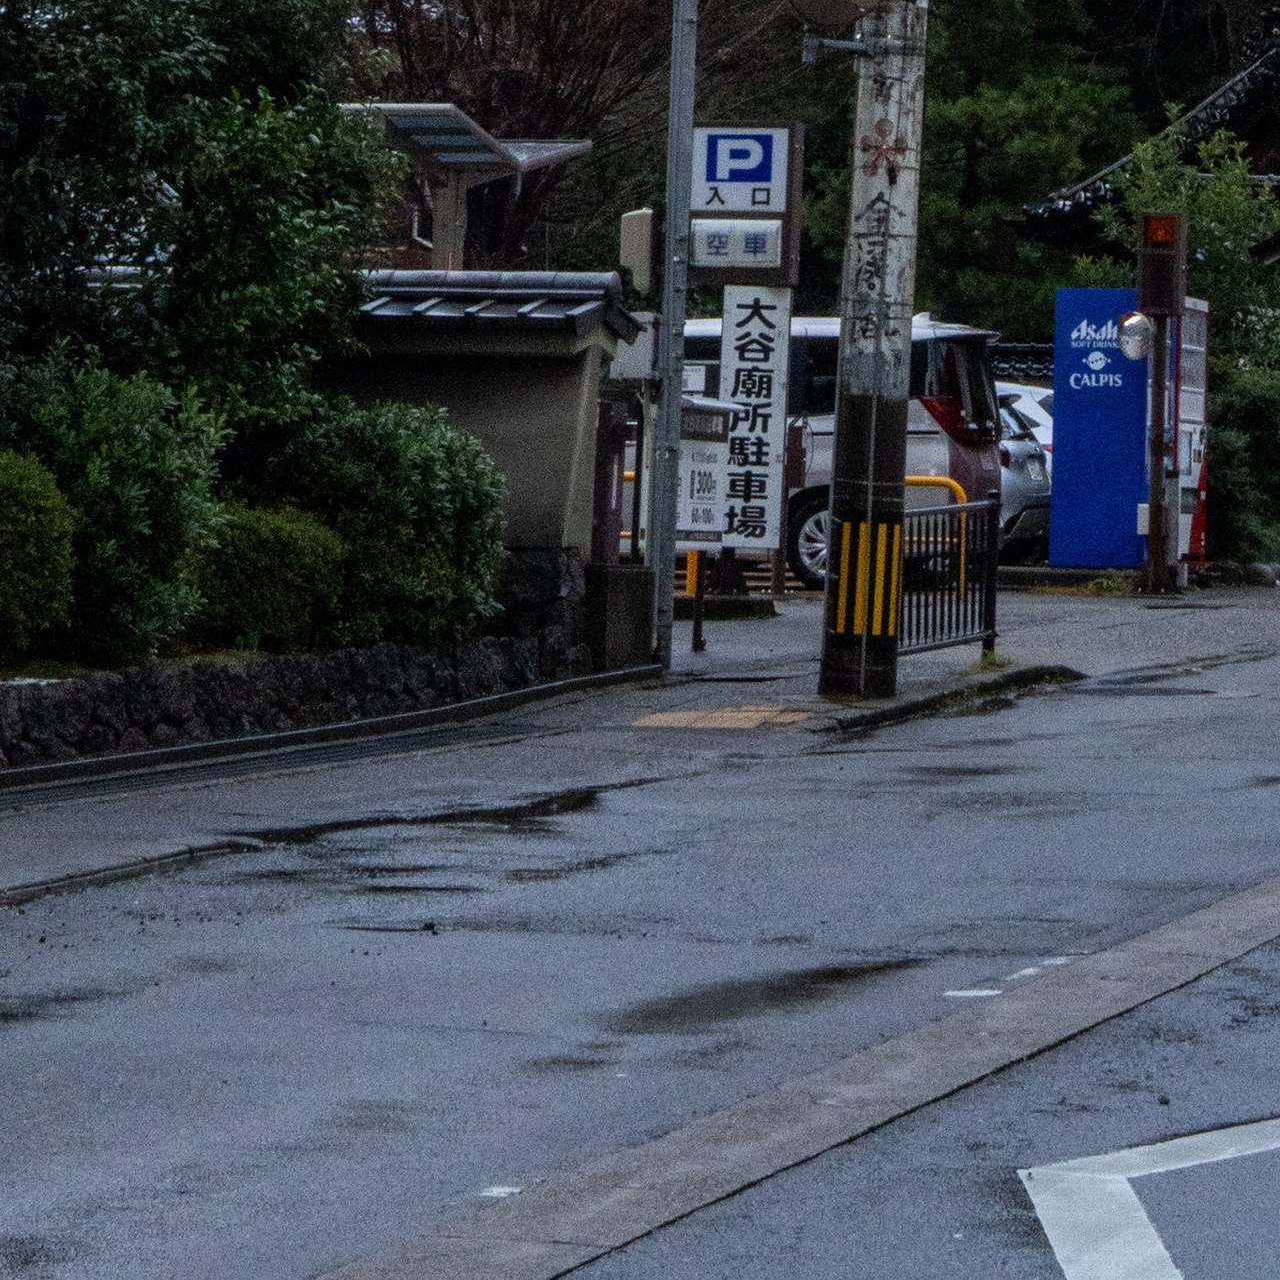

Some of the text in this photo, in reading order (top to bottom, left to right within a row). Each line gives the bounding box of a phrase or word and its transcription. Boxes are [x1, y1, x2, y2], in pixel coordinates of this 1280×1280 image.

[716, 138, 764, 180] P
[705, 187, 771, 206] 入口
[1070, 319, 1119, 340] Asah
[1092, 341, 1119, 349] DRINK
[1069, 373, 1123, 390] CALPIS
[724, 297, 778, 539] 大谷廟所駐車場
